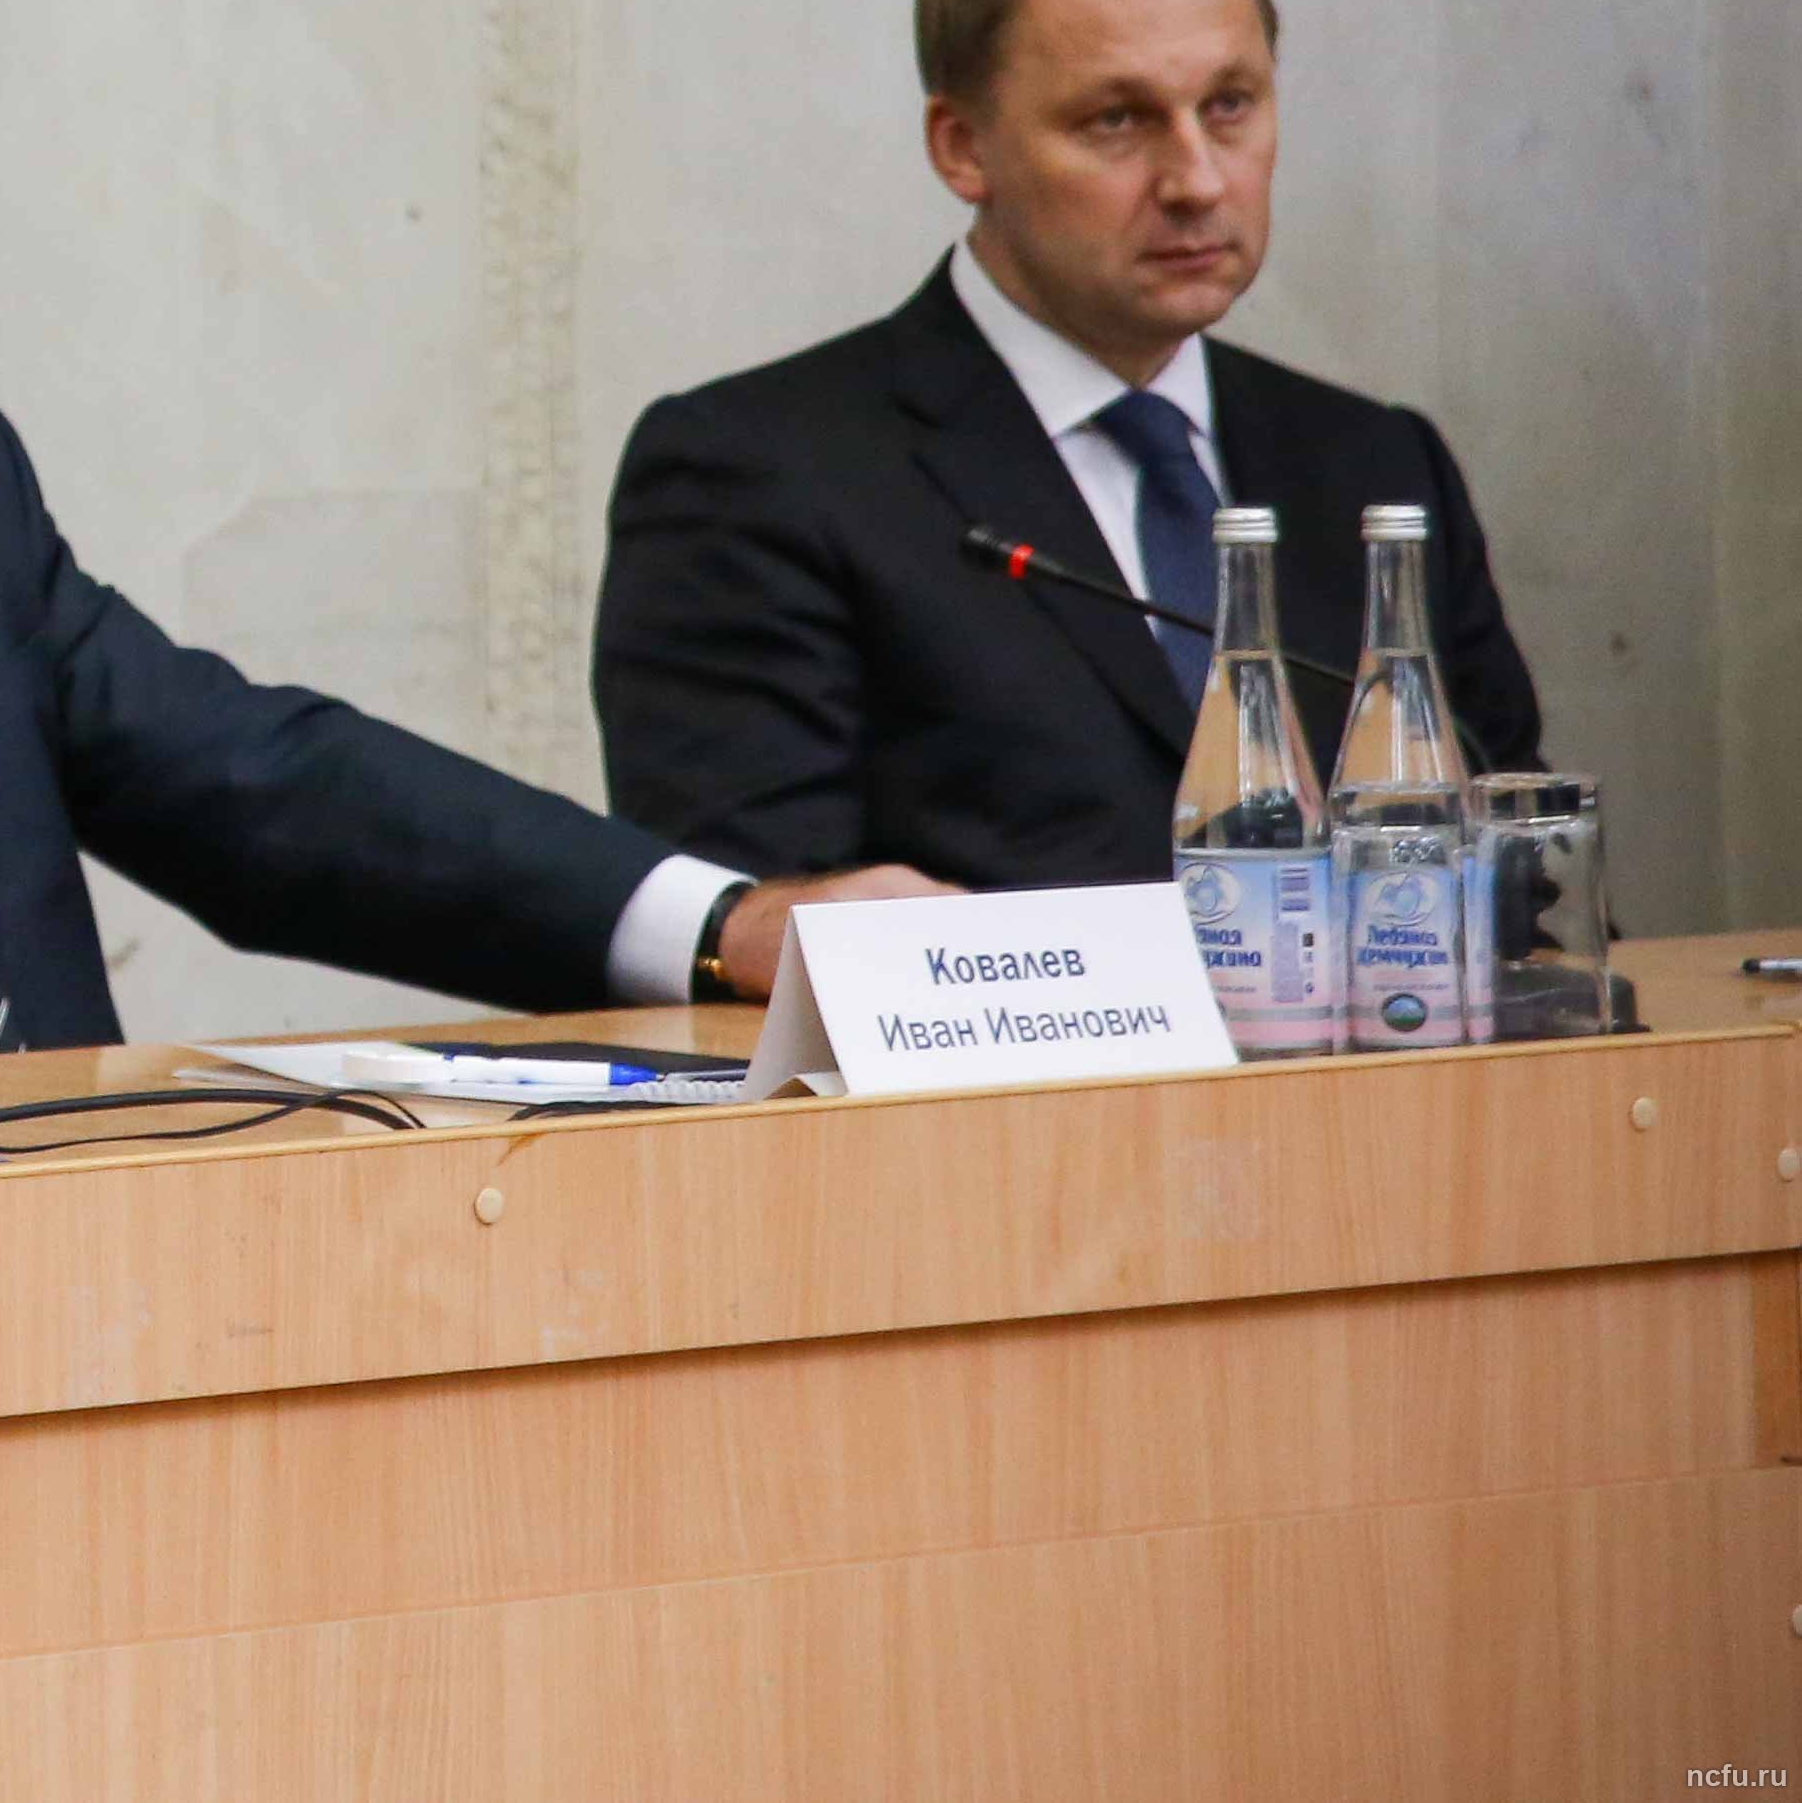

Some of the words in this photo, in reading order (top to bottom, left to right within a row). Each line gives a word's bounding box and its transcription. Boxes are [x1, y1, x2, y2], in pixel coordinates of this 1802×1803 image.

[925, 947, 1085, 986] Ковалев
[878, 1010, 976, 1053] Иван
[987, 1002, 1171, 1045] Иванович
